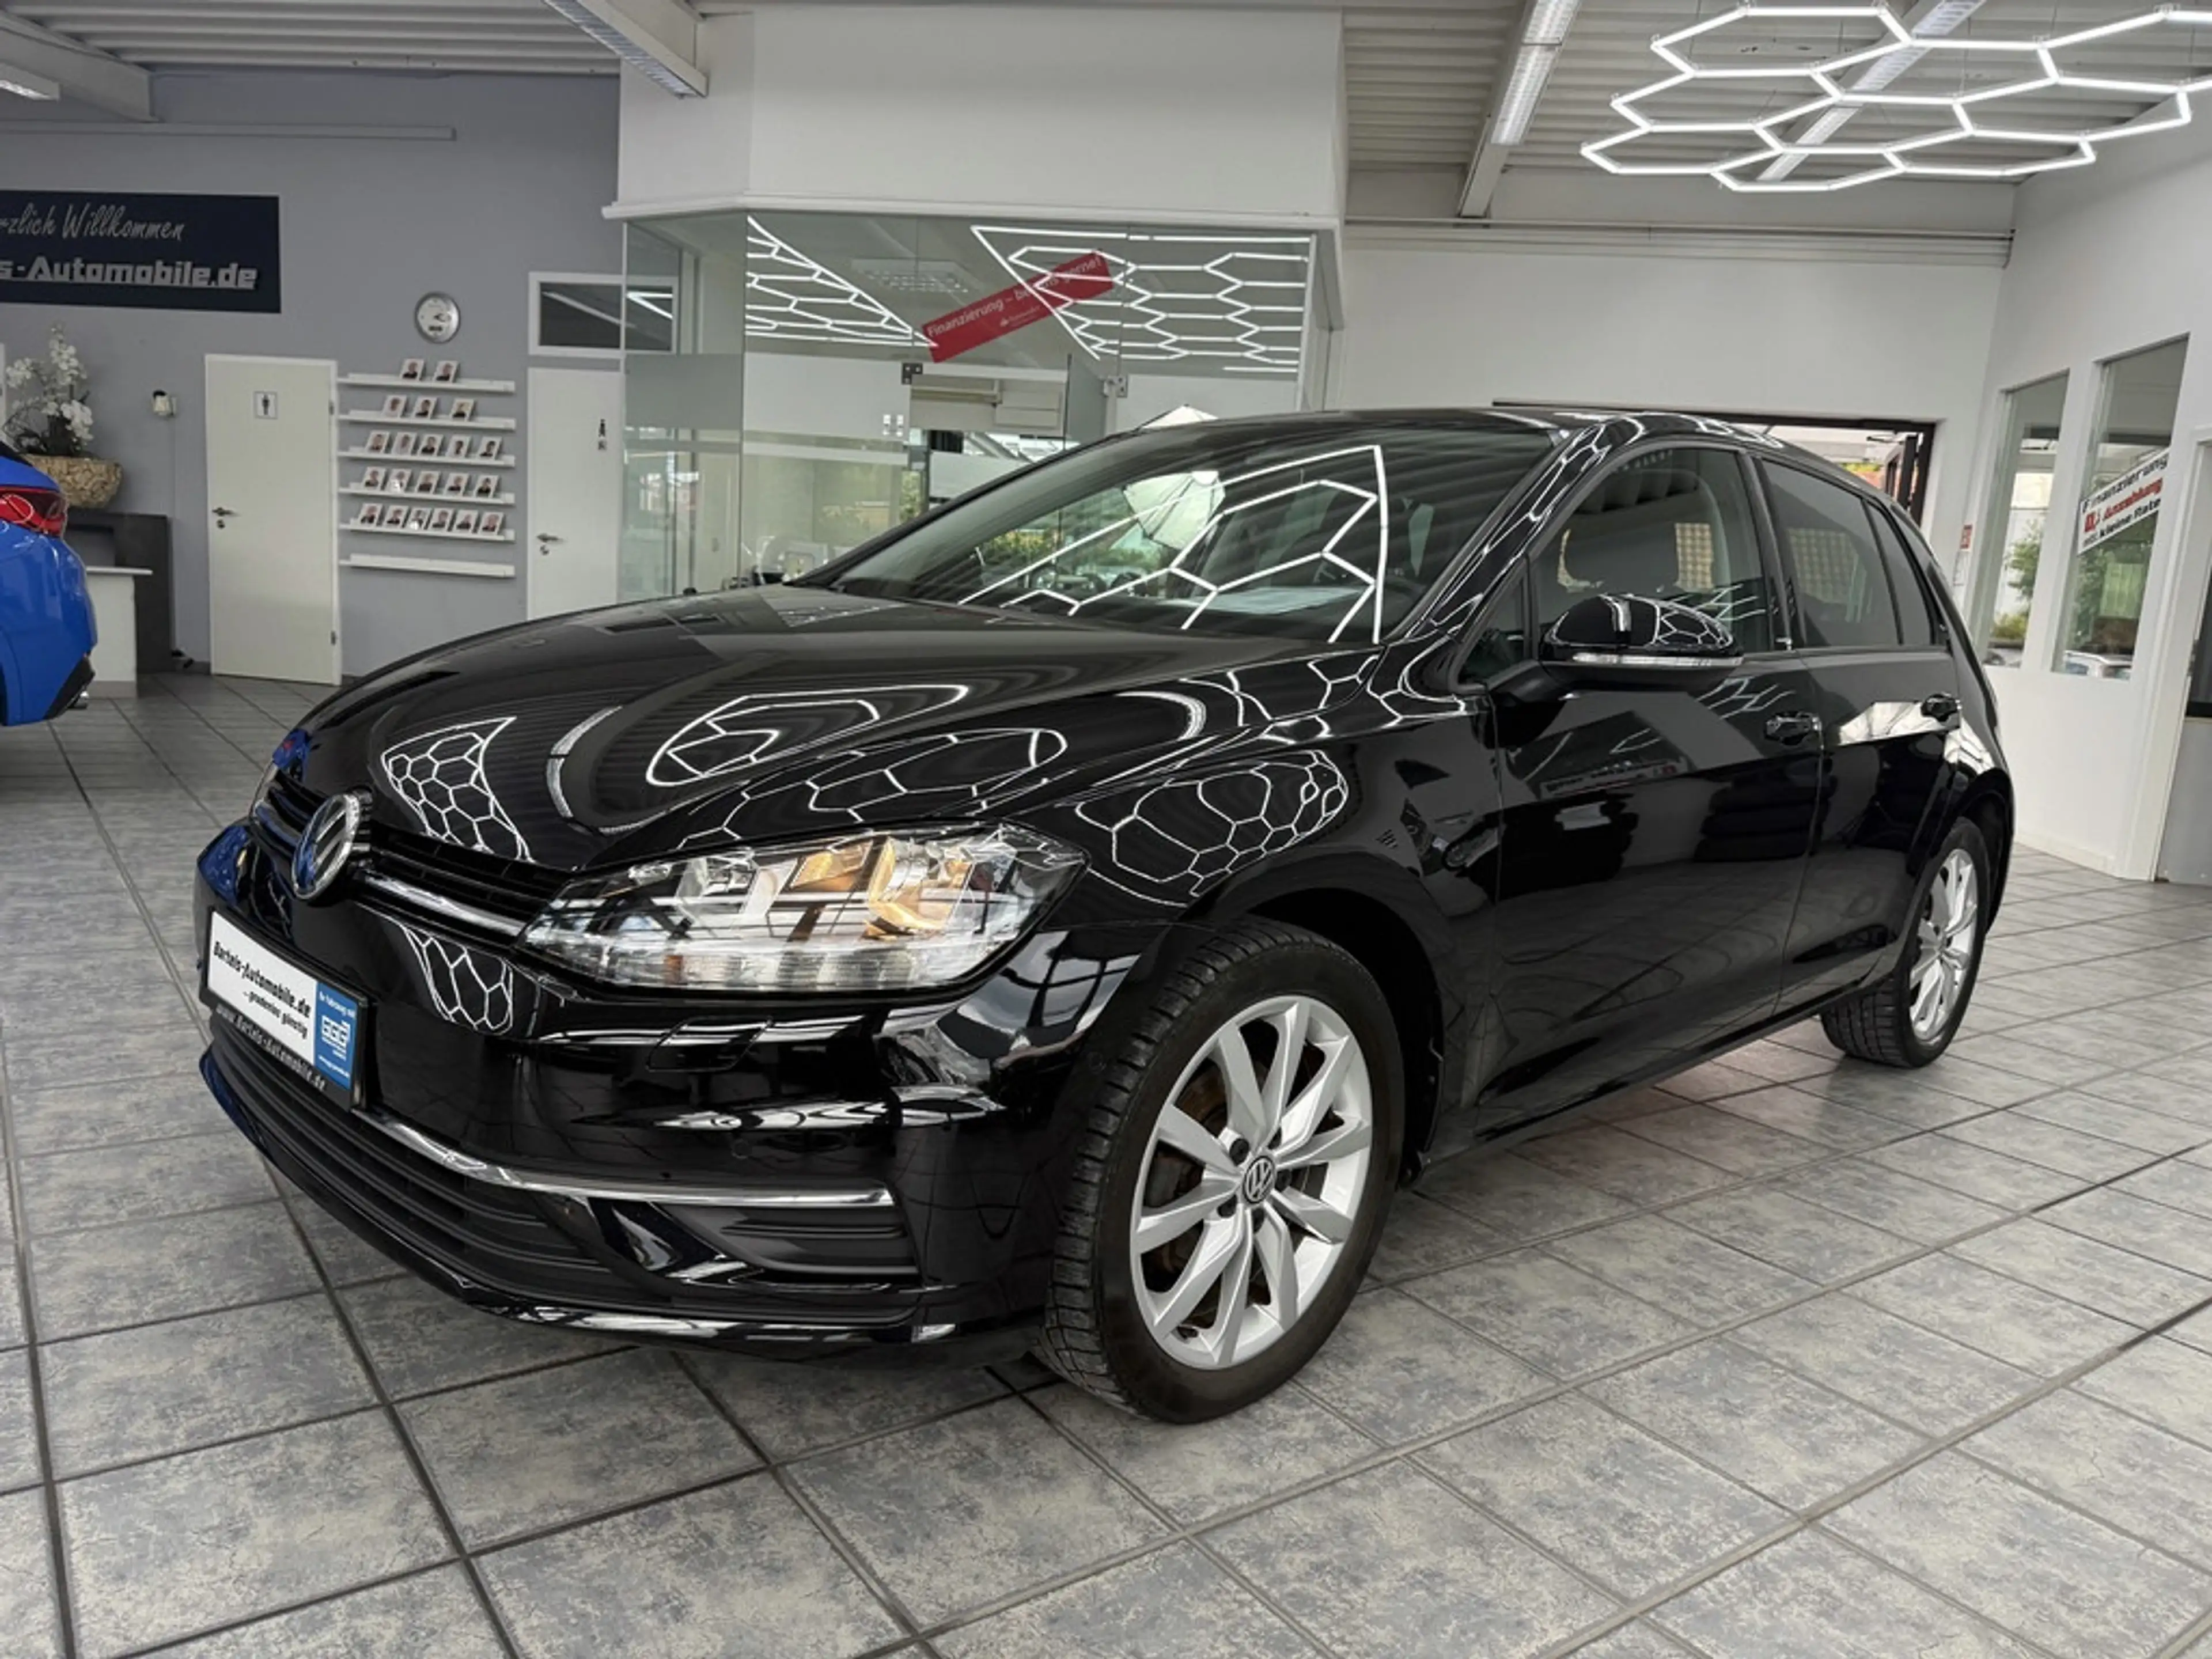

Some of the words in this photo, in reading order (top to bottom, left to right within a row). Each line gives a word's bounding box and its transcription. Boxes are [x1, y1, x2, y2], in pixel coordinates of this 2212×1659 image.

[62, 202, 185, 242] Willkommen
[0, 256, 257, 290] s-Automobile.de
[926, 298, 1004, 338] Finanzierung
